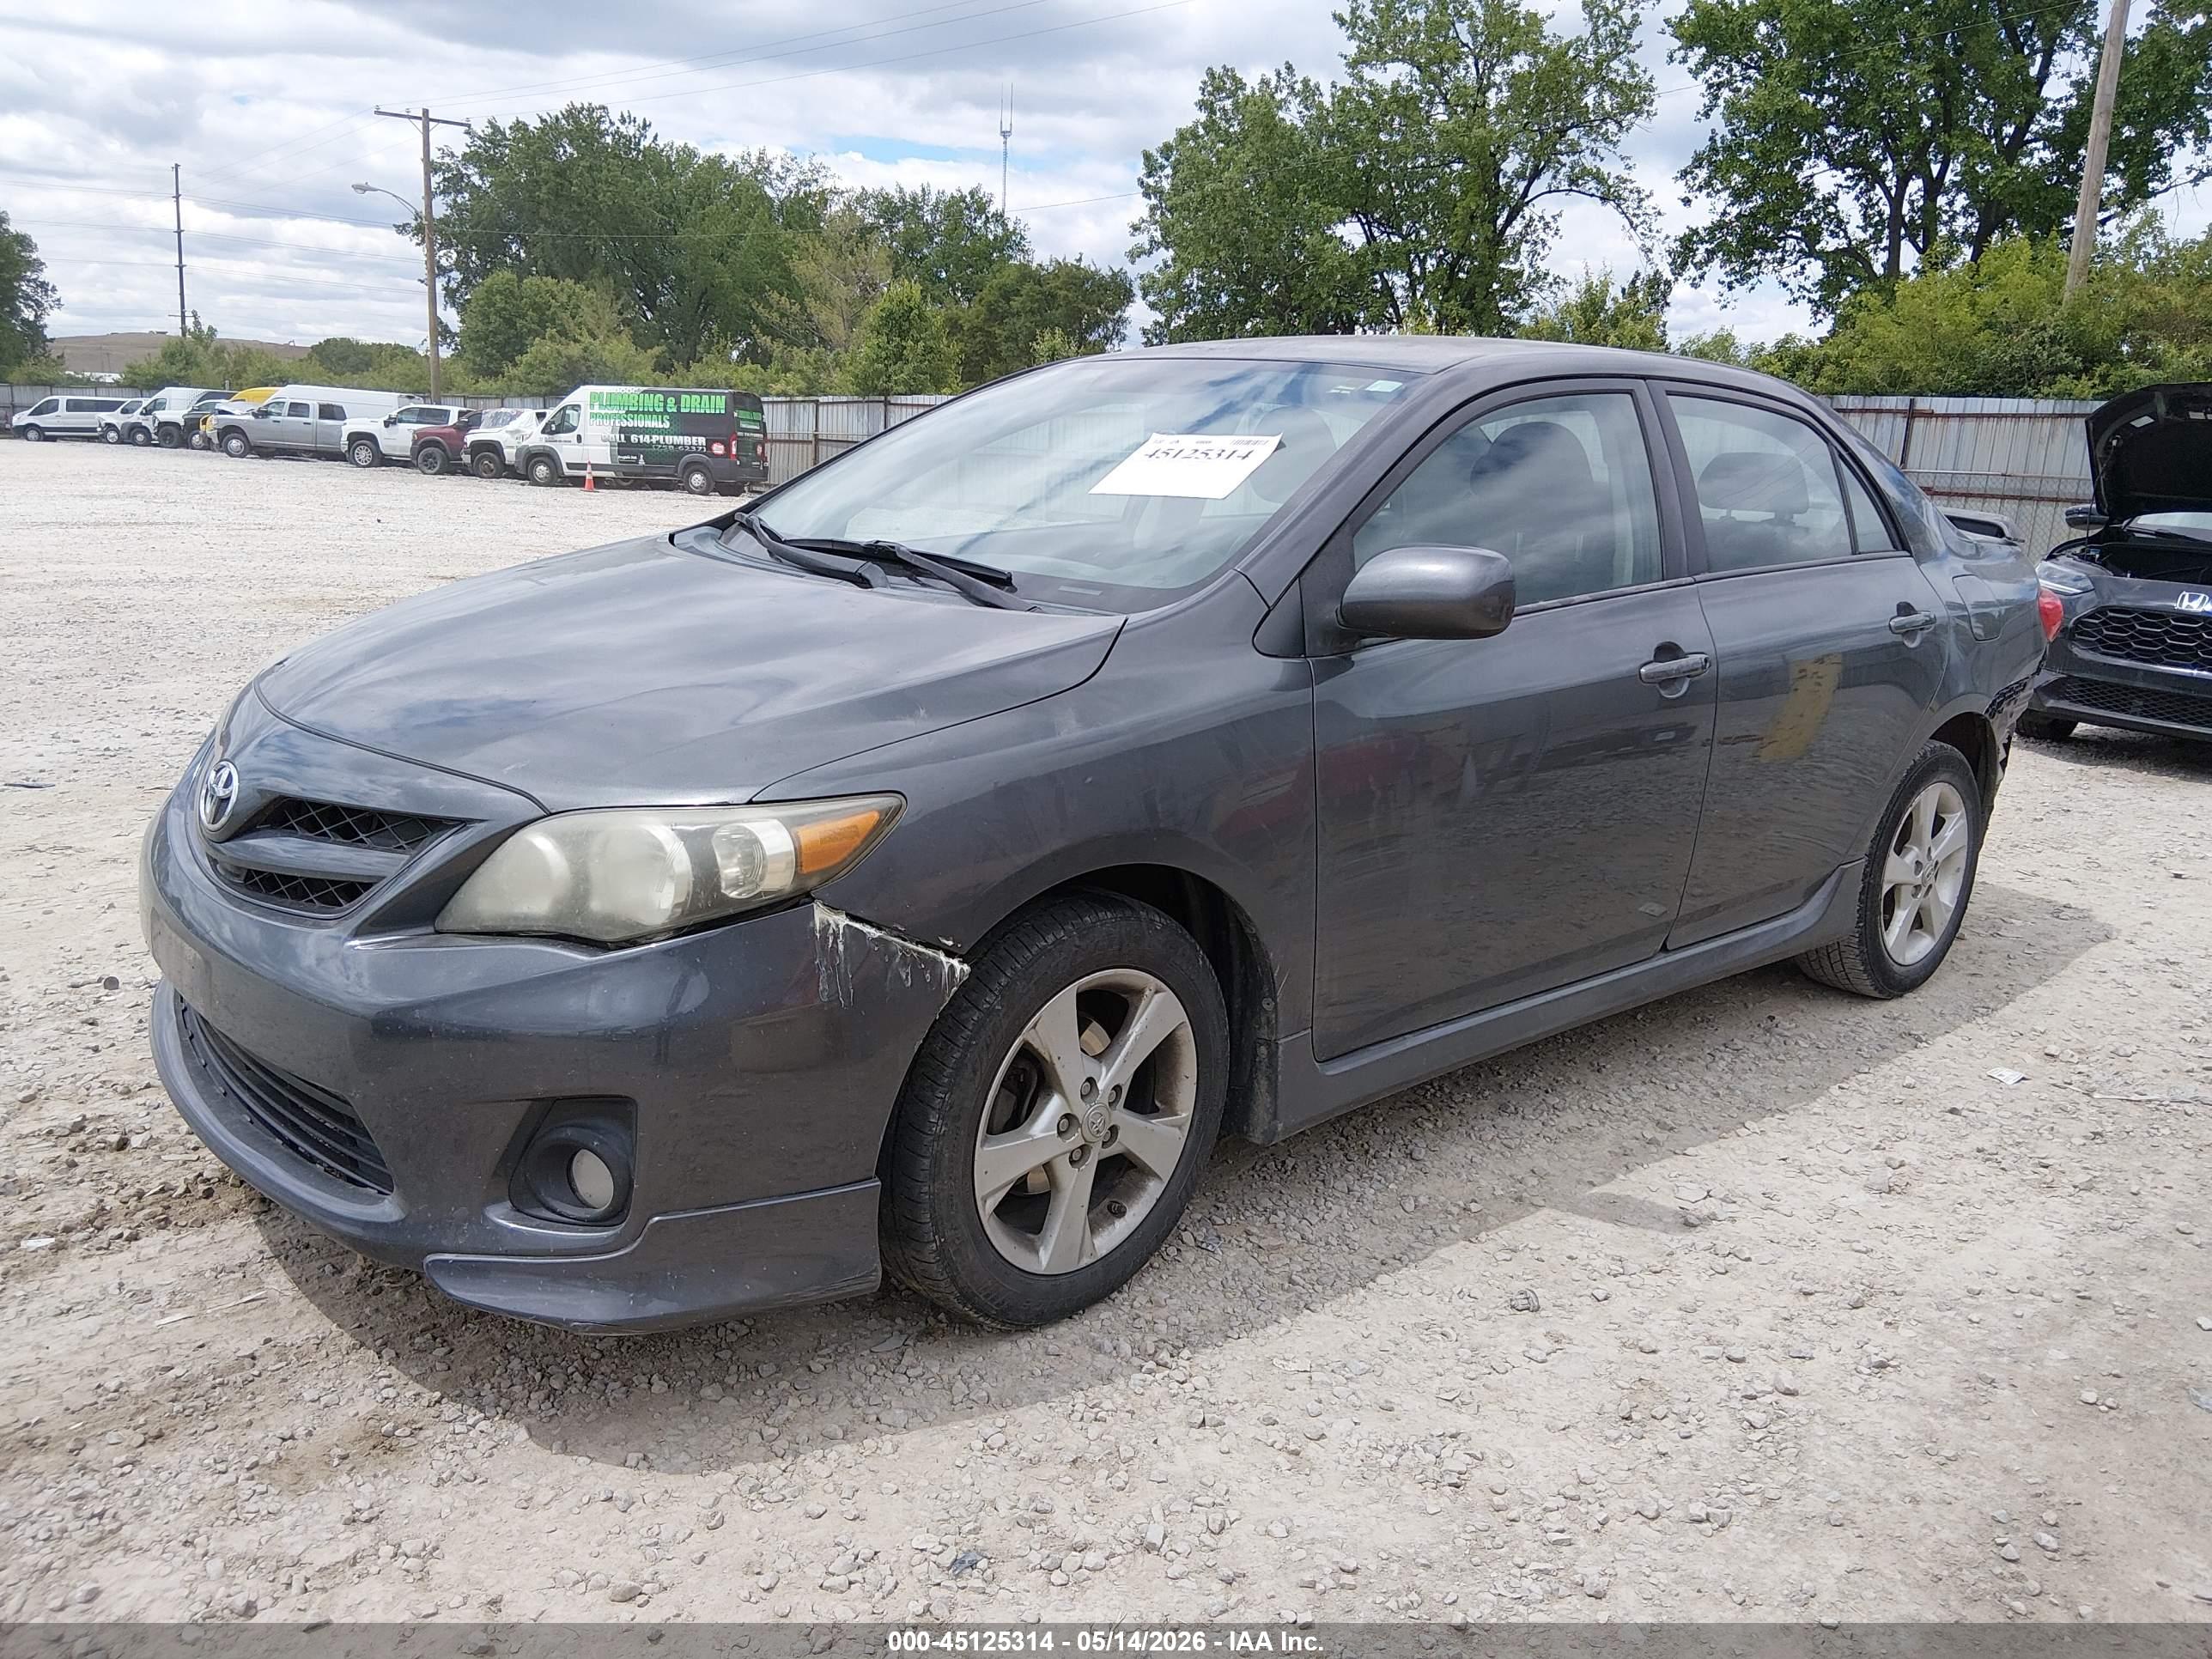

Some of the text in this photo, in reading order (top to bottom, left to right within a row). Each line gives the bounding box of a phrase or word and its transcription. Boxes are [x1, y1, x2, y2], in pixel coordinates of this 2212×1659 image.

[589, 392, 726, 413] PLUMBING & DRAIN
[589, 412, 670, 428] PROFESSIONALS
[601, 433, 706, 446] CALL 614-PLUMBER
[1145, 447, 1255, 460] 45125314
